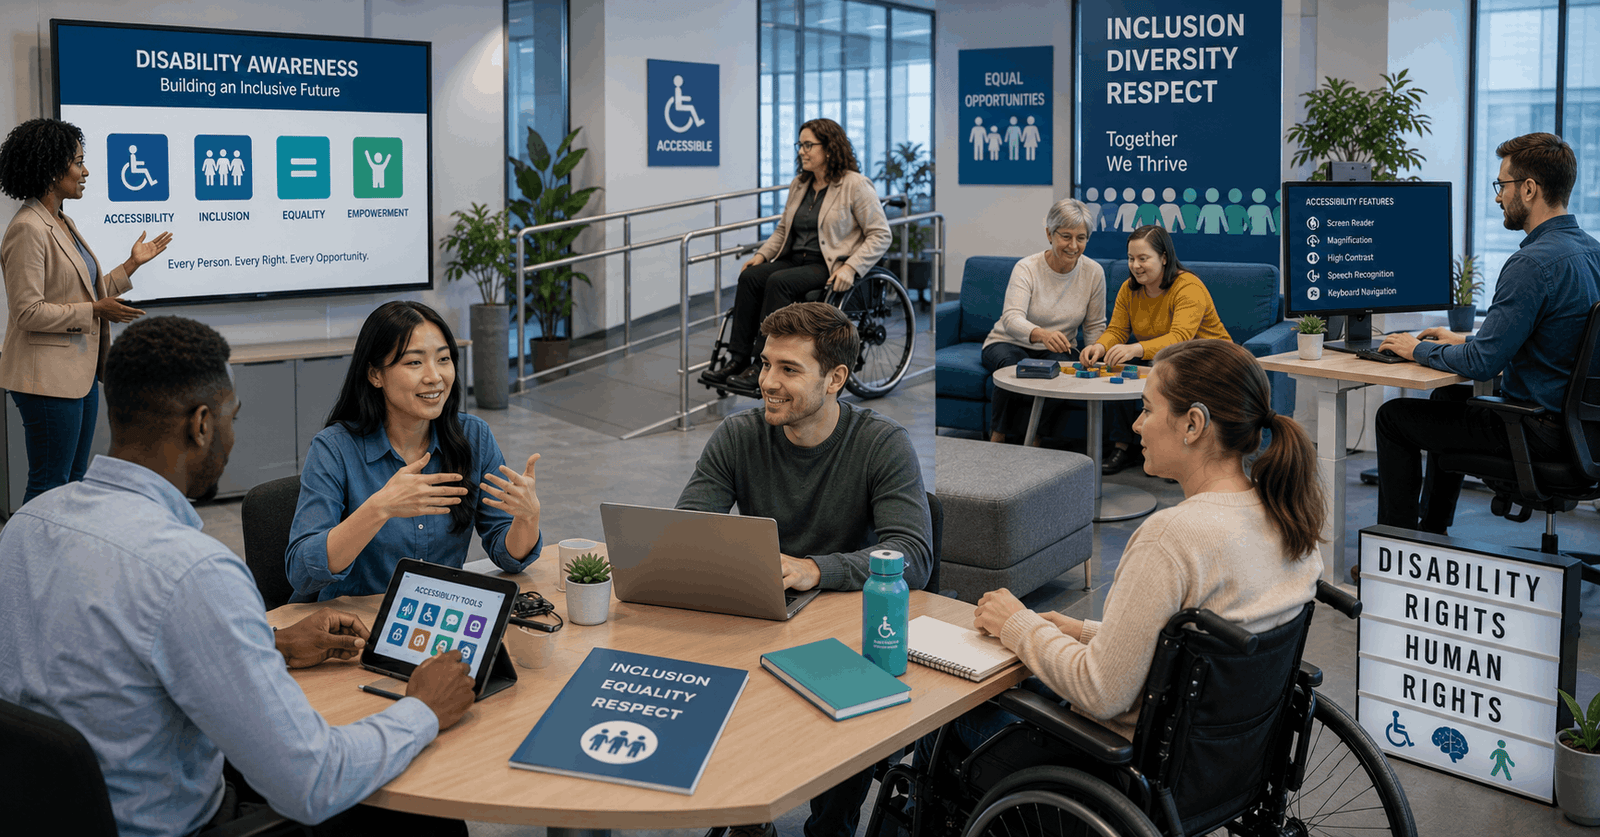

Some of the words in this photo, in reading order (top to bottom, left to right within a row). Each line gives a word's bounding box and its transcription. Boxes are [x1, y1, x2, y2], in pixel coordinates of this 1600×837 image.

[1106, 13, 1245, 40] INCLUSION
[136, 49, 241, 72] DISABILITY
[247, 56, 358, 77] AWARENESS
[1106, 47, 1238, 72] DIVERSITY
[160, 77, 216, 96] Building
[220, 80, 237, 94] an
[240, 81, 297, 96] Inclusive
[300, 83, 340, 97] Future
[985, 72, 1024, 86] EQUAL
[965, 92, 1045, 107] OPPORTUNITIES
[1106, 80, 1218, 104] RESPECT
[656, 140, 712, 152] ACCESSIBLE
[1106, 130, 1178, 150] Together
[1106, 156, 1132, 172] We
[1137, 155, 1188, 172] Thrive
[1306, 197, 1357, 206] ACCESSIBILITY
[1359, 197, 1394, 206] FEATURES
[104, 212, 174, 224] ACCESSIBILITY
[199, 211, 250, 222] INCLUSION
[282, 210, 325, 221] EQUALITY
[347, 208, 409, 218] EMPOWERMENT
[1327, 219, 1350, 227] Screen
[1351, 219, 1375, 227] Reader
[1327, 236, 1373, 246] Magnification
[168, 258, 195, 271] Every
[197, 257, 232, 268] Person.
[234, 256, 260, 268] Every
[262, 254, 288, 267] Right.
[290, 254, 314, 266] Every
[316, 251, 369, 265] Opportunity.
[1327, 254, 1344, 263] High
[1344, 253, 1374, 262] Contrast
[1327, 271, 1353, 280] Speech
[1354, 270, 1394, 279] Recognition
[1328, 289, 1360, 298] Keyboard
[1361, 287, 1397, 297] Navigation
[1379, 547, 1540, 602] DISABILITY
[414, 586, 460, 602] ACCESSIBILITY
[461, 597, 483, 608] TOOLS
[1405, 593, 1506, 639] RIGHTS
[1406, 634, 1502, 682] HUMAN
[609, 662, 711, 687] INCLUSION
[601, 679, 697, 703] EQUALITY
[1403, 674, 1502, 723] RIGHTS
[591, 697, 683, 720] RESPECT
